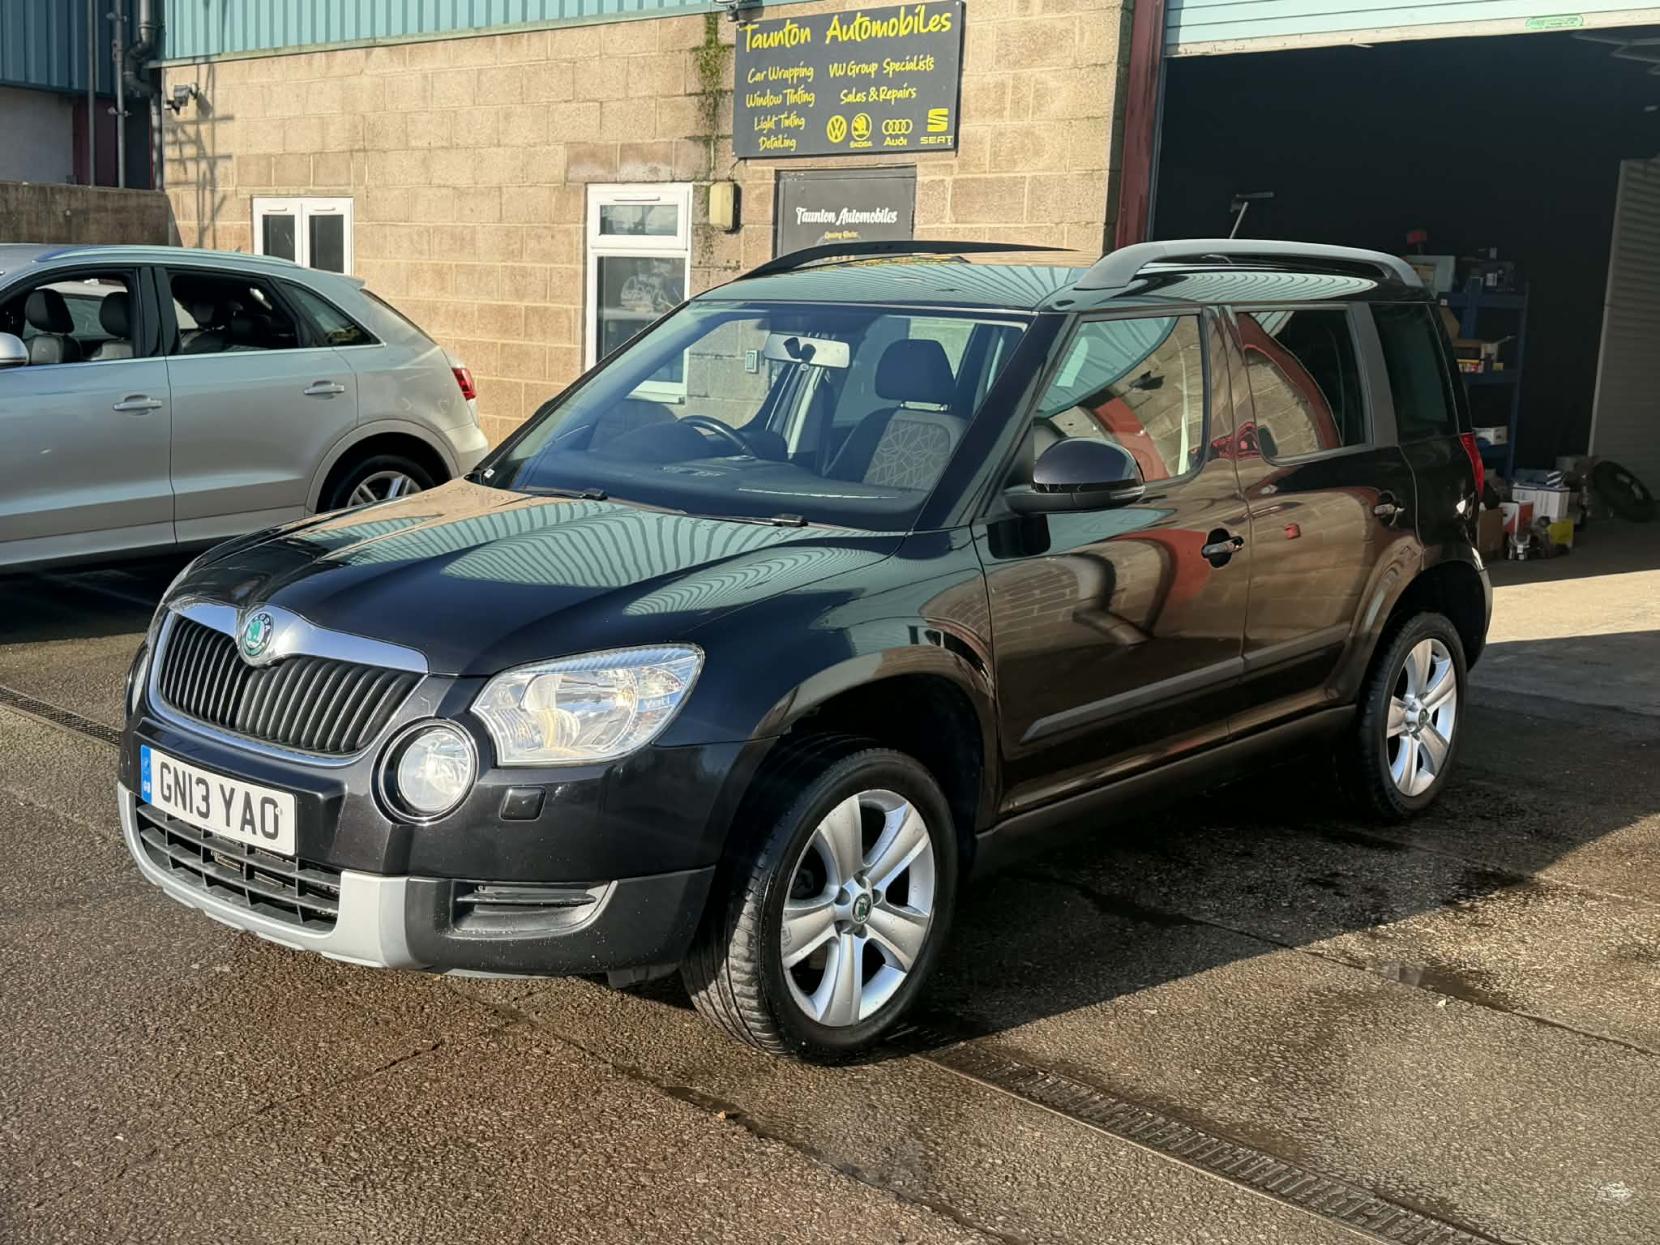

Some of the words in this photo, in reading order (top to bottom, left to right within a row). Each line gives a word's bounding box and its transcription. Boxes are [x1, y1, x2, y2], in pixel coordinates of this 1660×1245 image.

[739, 19, 812, 52] Taunton
[825, 5, 952, 44] Automobiles
[747, 68, 767, 84] Car
[768, 61, 814, 84] Wrapping
[828, 62, 846, 78] VW
[847, 61, 878, 78] Group
[882, 54, 935, 78] Specialists
[745, 88, 783, 108] Window
[783, 84, 816, 107] Tinting
[840, 87, 867, 104] Sales
[868, 86, 879, 102] &
[879, 82, 917, 105] Repairs
[754, 114, 778, 133] Light
[778, 110, 805, 130] Tinting
[758, 133, 797, 152] Detailing
[883, 136, 908, 146] Audi
[920, 135, 953, 146] SEAT
[795, 206, 837, 225] Taunton
[836, 206, 898, 225] Automobiles
[160, 761, 211, 820] GN13
[219, 783, 280, 841] YAO
